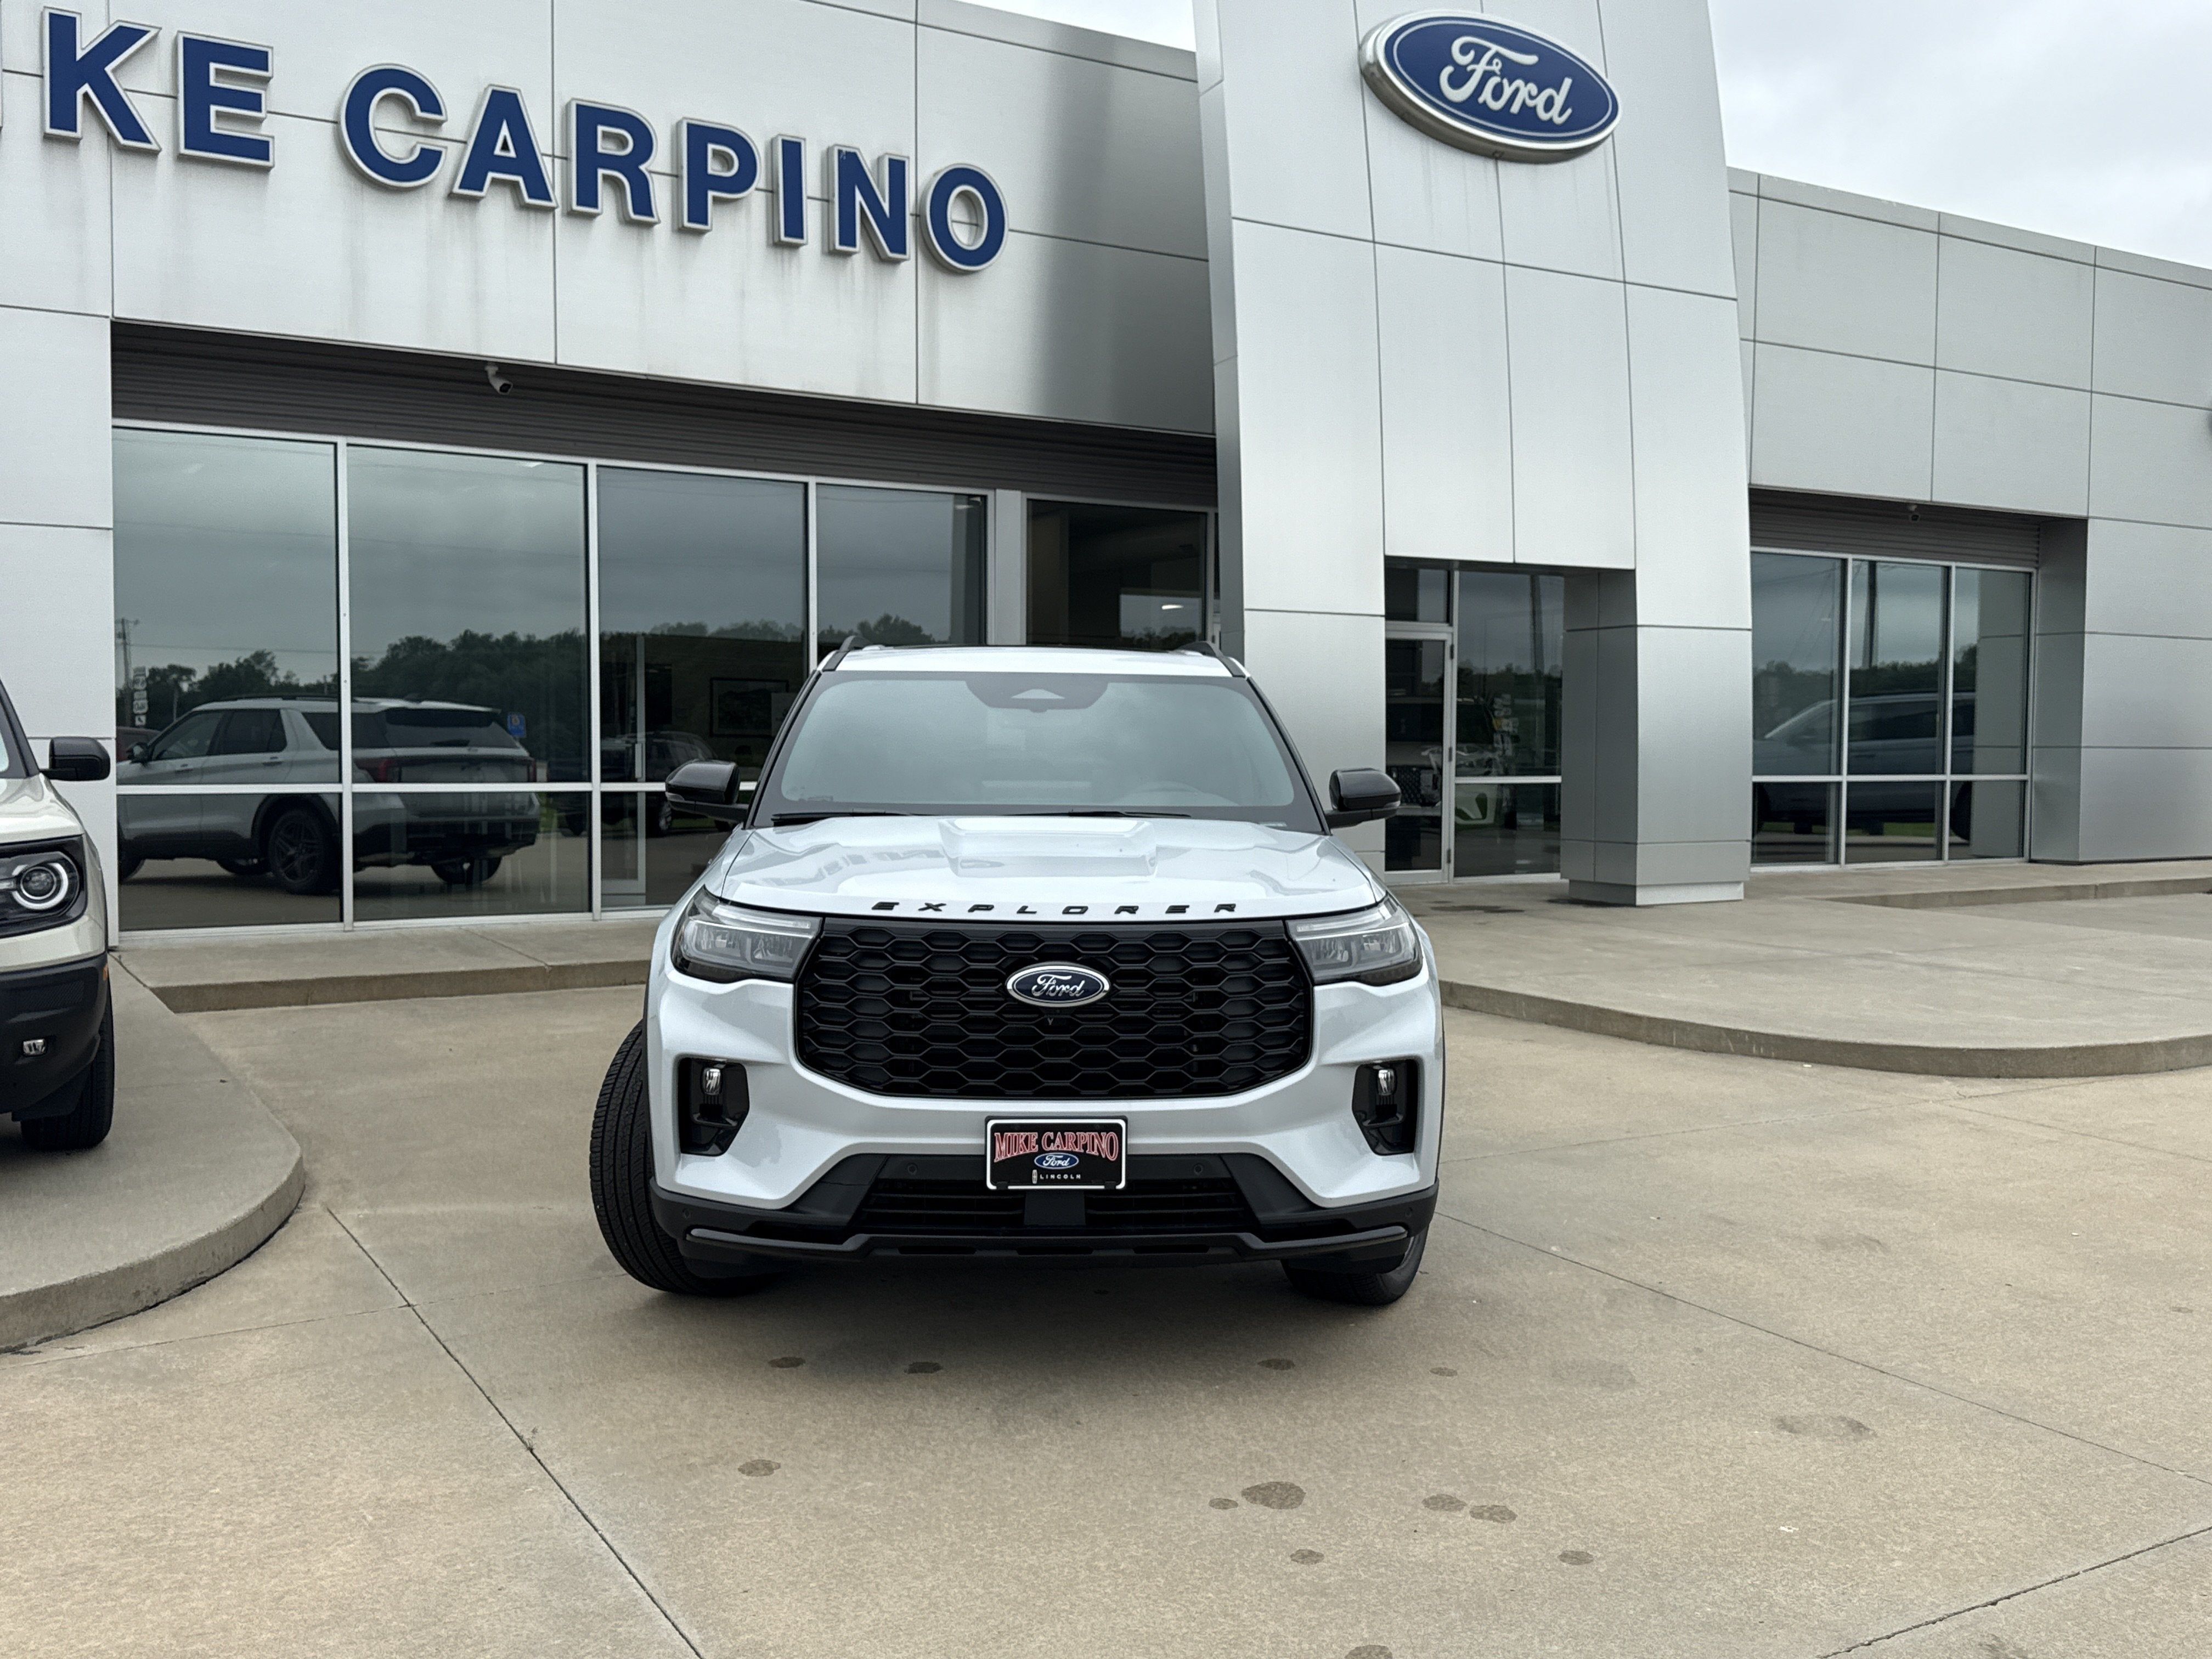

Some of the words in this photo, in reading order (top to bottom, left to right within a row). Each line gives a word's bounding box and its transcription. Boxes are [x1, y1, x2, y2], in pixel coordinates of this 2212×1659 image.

[1439, 36, 1573, 125] Ford
[42, 5, 274, 169] KE
[338, 63, 1008, 273] CARPINO
[871, 901, 1237, 915] EXPLORER
[1031, 973, 1085, 997] Ford
[994, 1132, 1038, 1163] MIKE
[1041, 1131, 1119, 1161] CARPINO
[1042, 1154, 1070, 1166] Ford
